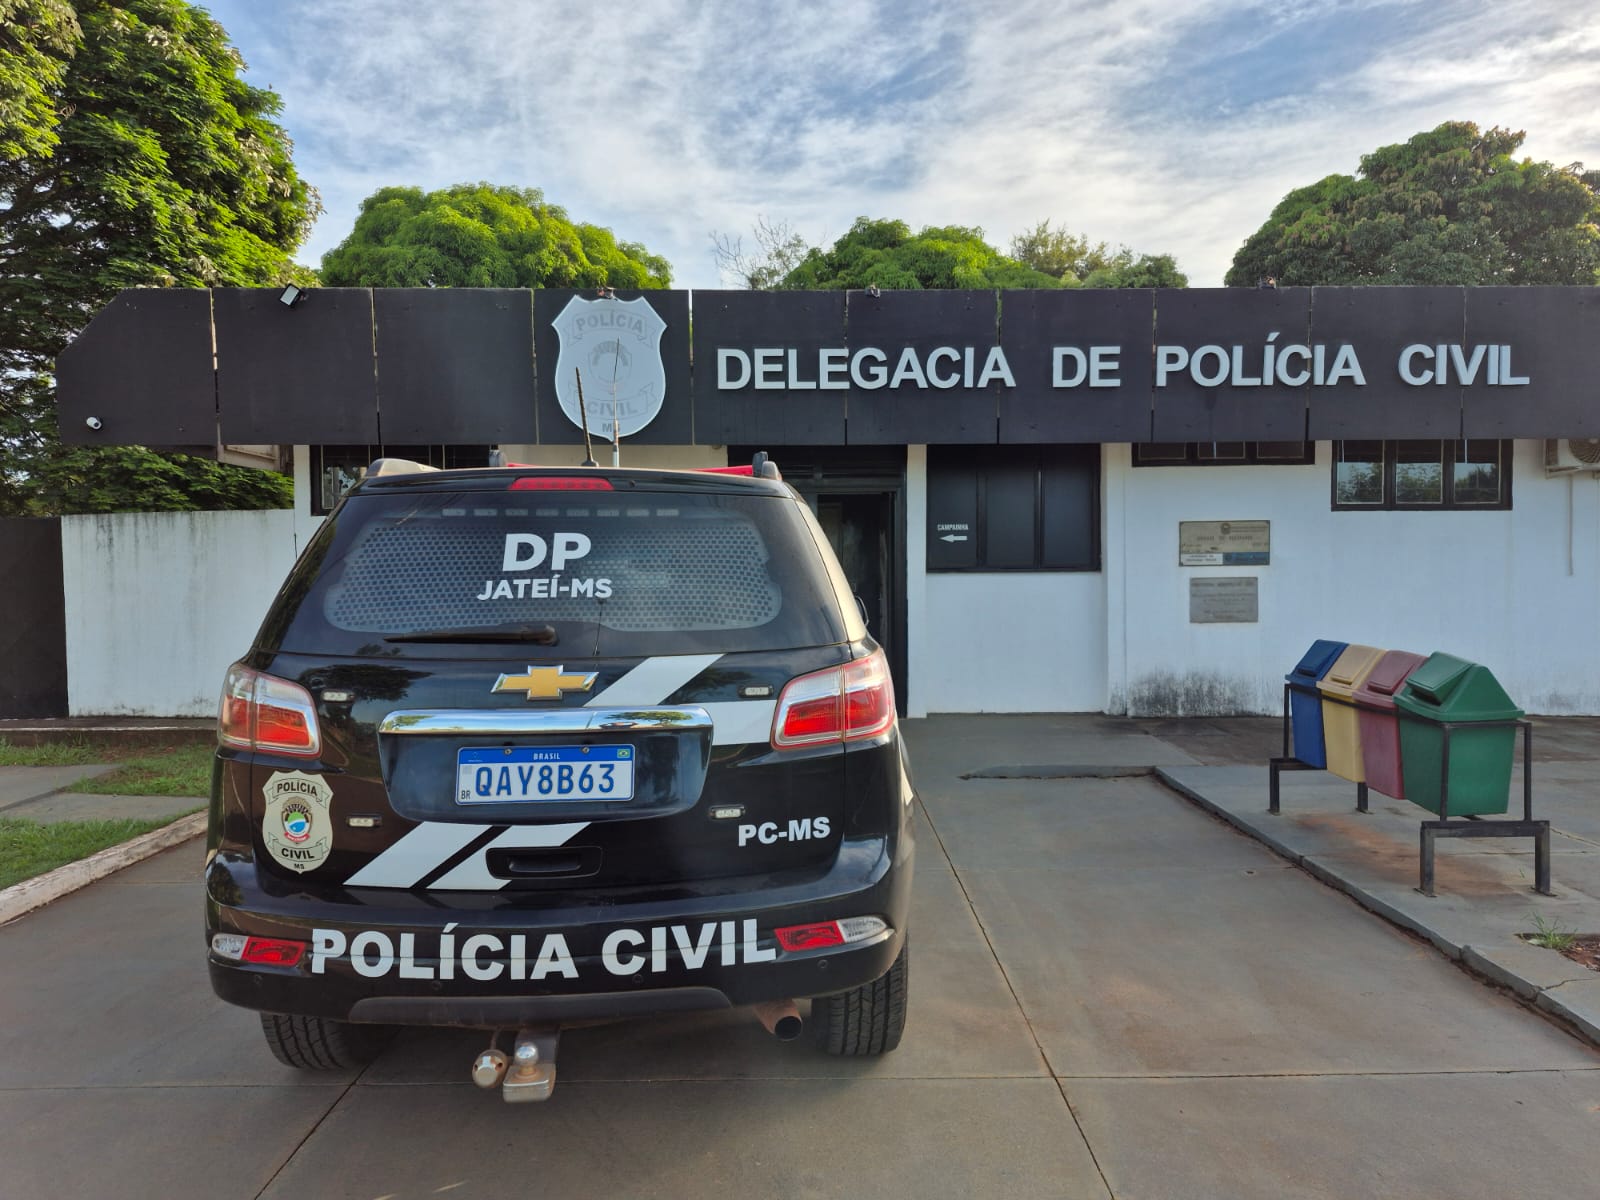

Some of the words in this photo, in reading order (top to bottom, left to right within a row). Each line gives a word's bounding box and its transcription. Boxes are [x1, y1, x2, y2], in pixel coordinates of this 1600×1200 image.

[576, 311, 643, 333] POLÍCIA
[717, 346, 1016, 390] DELEGACIA
[1052, 346, 1121, 390] DE
[1156, 332, 1366, 387] POLÍCIA
[1399, 343, 1530, 386] CIVIL
[587, 401, 638, 417] CIVIL
[502, 532, 592, 572] DP
[477, 574, 612, 601] JATEÍ-MS
[533, 752, 560, 761] BRASIL
[277, 780, 318, 796] POLÍCIA
[475, 764, 615, 797] QAY8B63
[461, 790, 471, 800] BR
[738, 817, 831, 847] PC-MS
[281, 848, 315, 859] CIVIL
[311, 922, 579, 981] POLÍCIA
[601, 918, 777, 976] CIVIL
